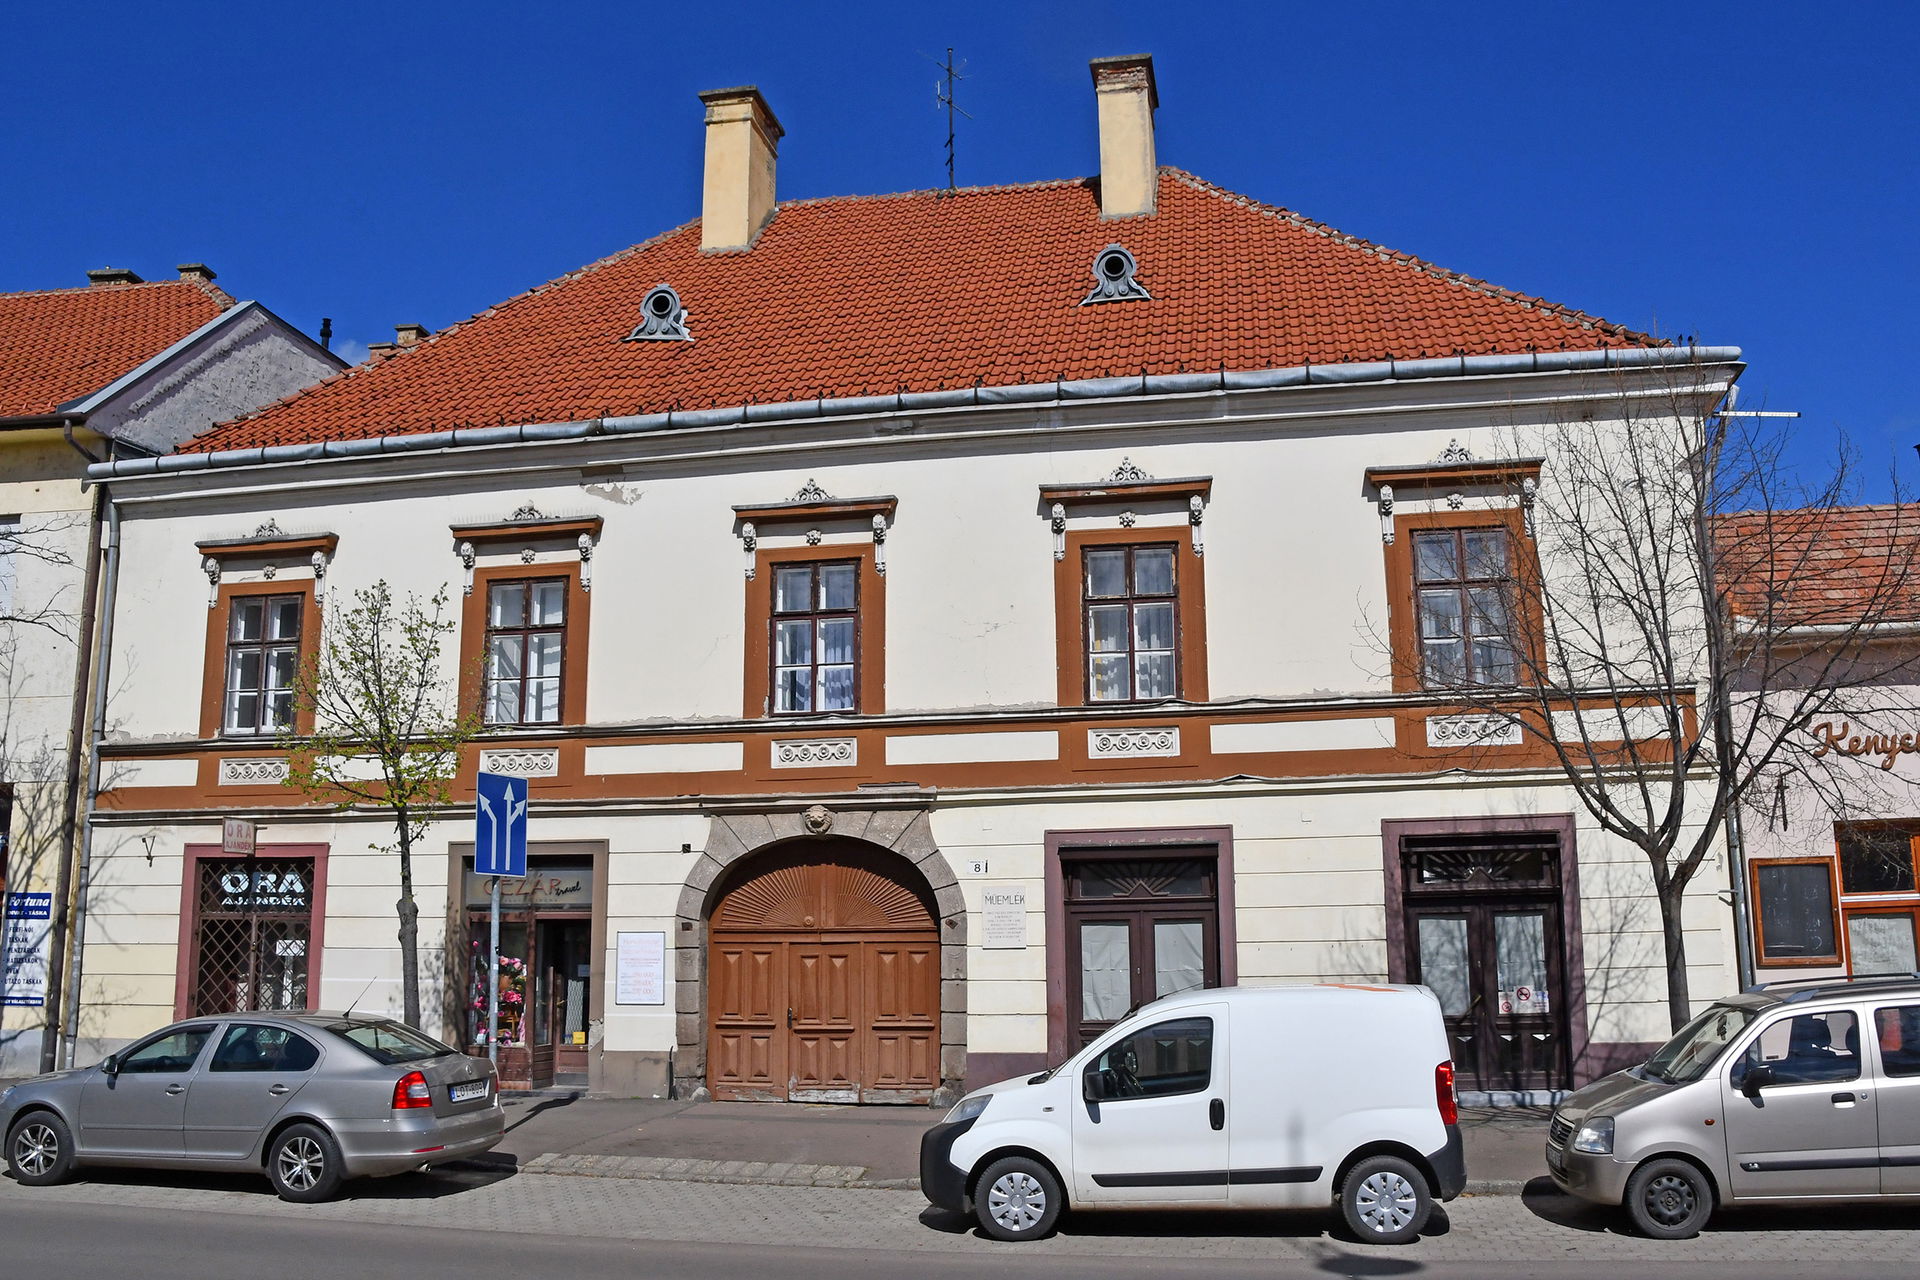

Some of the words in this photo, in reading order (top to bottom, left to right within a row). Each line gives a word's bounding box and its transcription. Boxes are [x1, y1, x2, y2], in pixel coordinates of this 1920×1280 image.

[1813, 721, 1920, 770] Kenye
[974, 863, 981, 872] 8
[555, 881, 581, 896] travel
[9, 896, 50, 907] Fortuna
